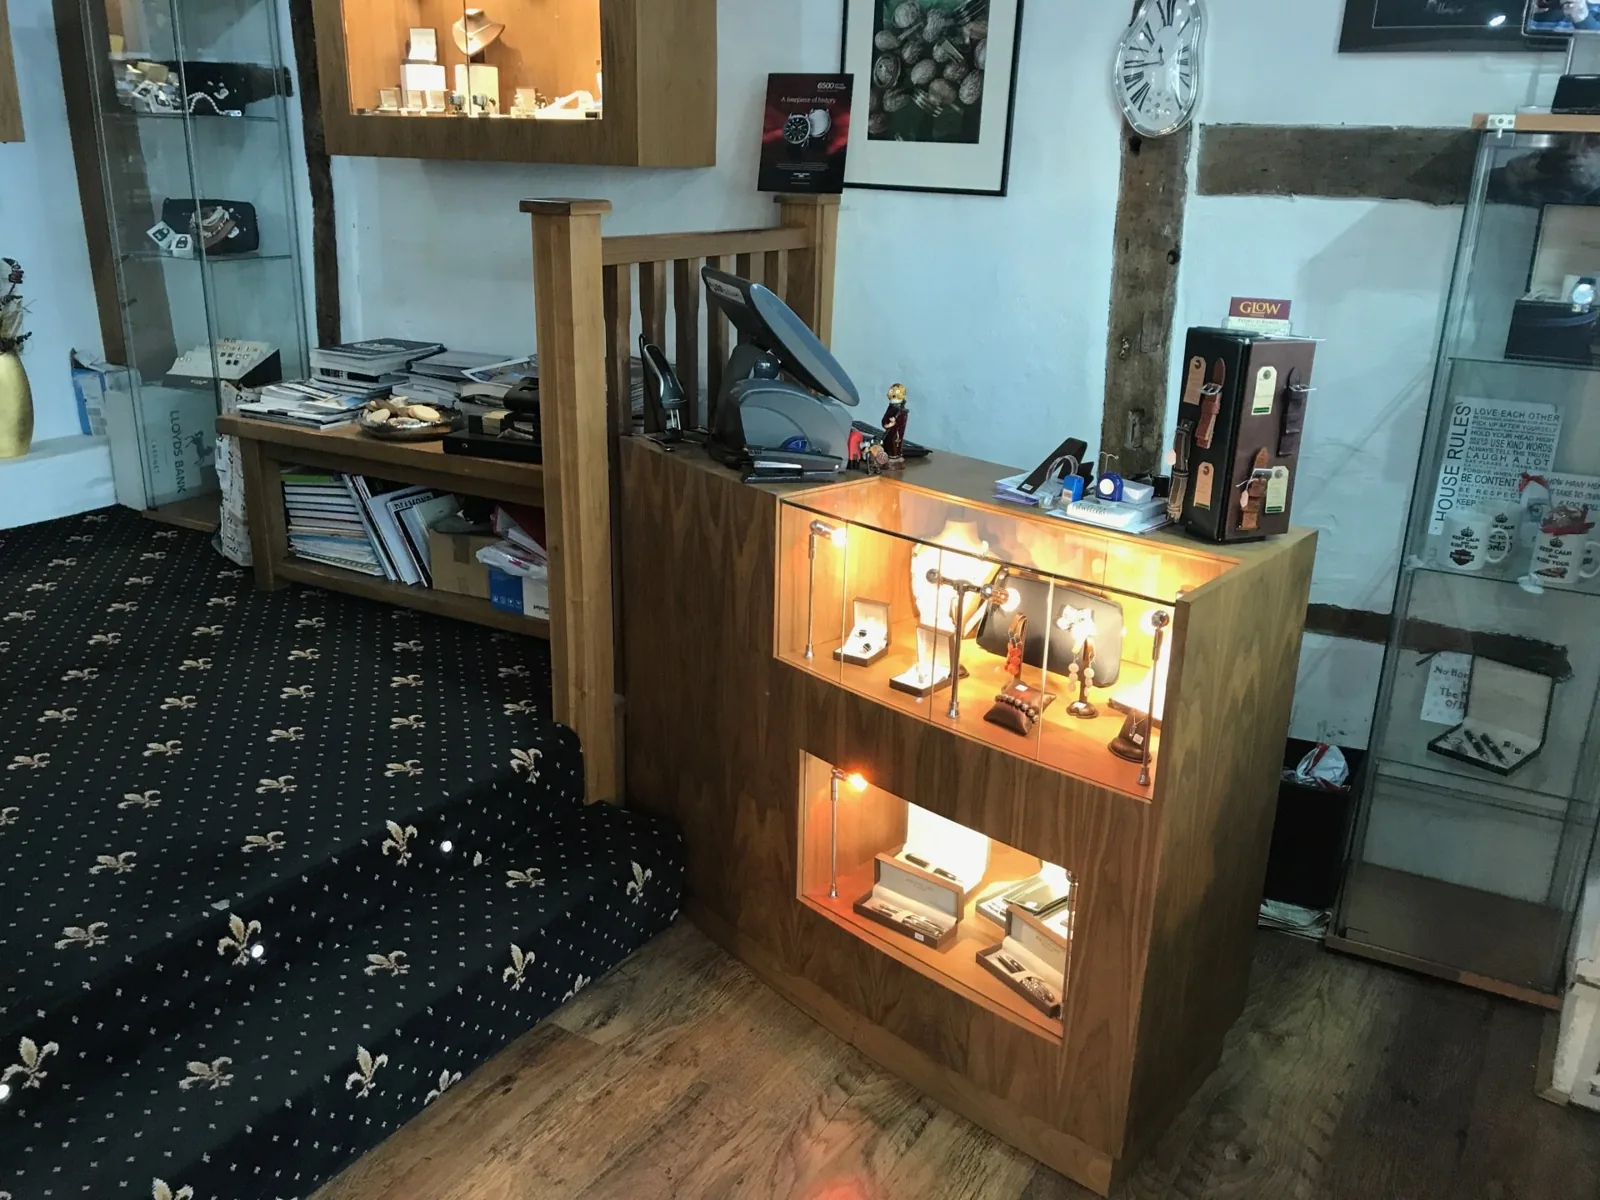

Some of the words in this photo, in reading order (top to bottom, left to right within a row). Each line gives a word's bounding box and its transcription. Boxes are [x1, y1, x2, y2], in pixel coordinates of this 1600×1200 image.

[1239, 301, 1281, 315] GLOW
[1474, 408, 1498, 416] LOVE
[1500, 410, 1526, 419] EACH
[1528, 412, 1560, 422] OTHER
[170, 410, 185, 457] LLOYDS
[1447, 404, 1472, 460] RULES
[1490, 440, 1505, 448] USE
[1506, 440, 1524, 450] KIND
[1526, 442, 1553, 453] WORDS
[1466, 452, 1507, 462] LAUGH
[1526, 458, 1550, 466] LOT
[174, 458, 187, 493] BANK
[1460, 472, 1472, 482] BE
[1474, 474, 1517, 487] CONTENT
[1435, 465, 1460, 522] HOUSE
[1456, 498, 1476, 506] KEEP
